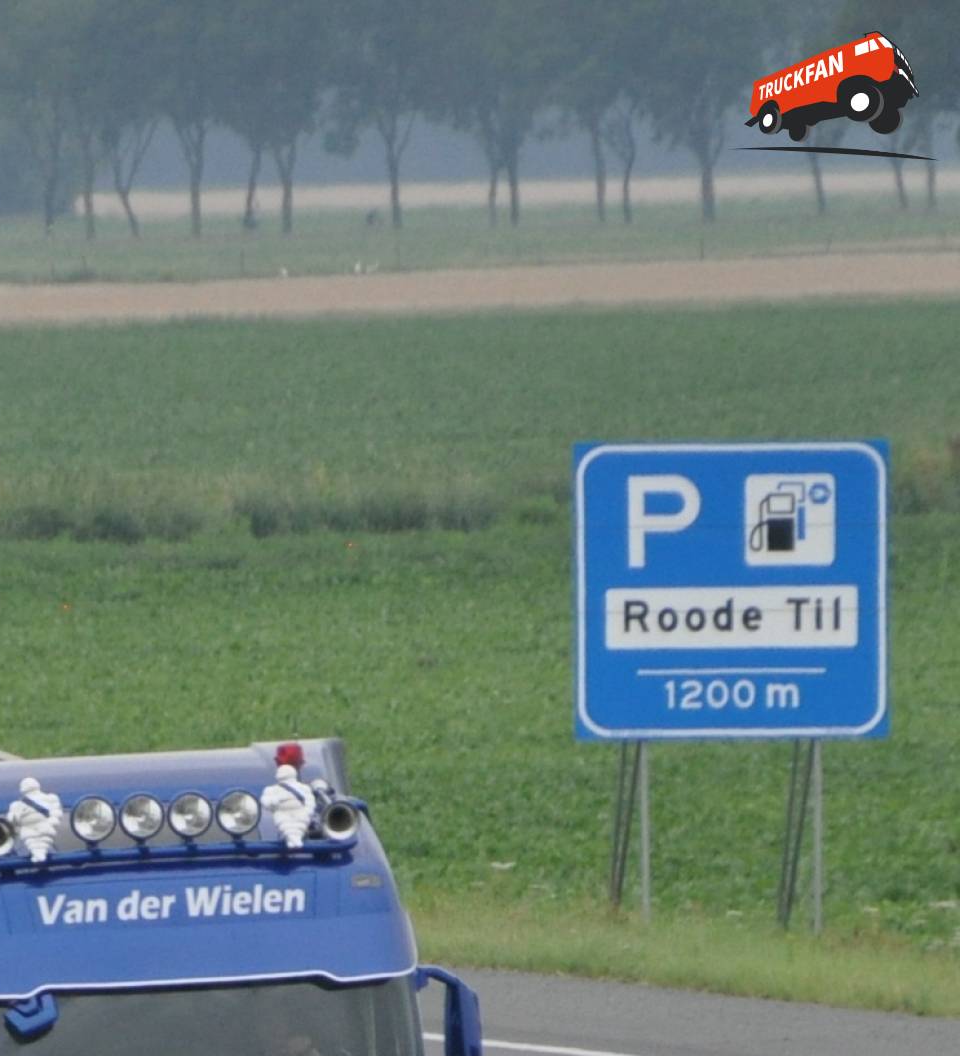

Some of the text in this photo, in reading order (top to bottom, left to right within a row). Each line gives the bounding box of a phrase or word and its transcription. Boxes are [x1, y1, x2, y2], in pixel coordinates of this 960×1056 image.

[628, 475, 701, 568] P
[623, 597, 841, 632] Roode Til
[664, 680, 800, 709] 1200 m
[38, 884, 305, 925] Van der Wielen
